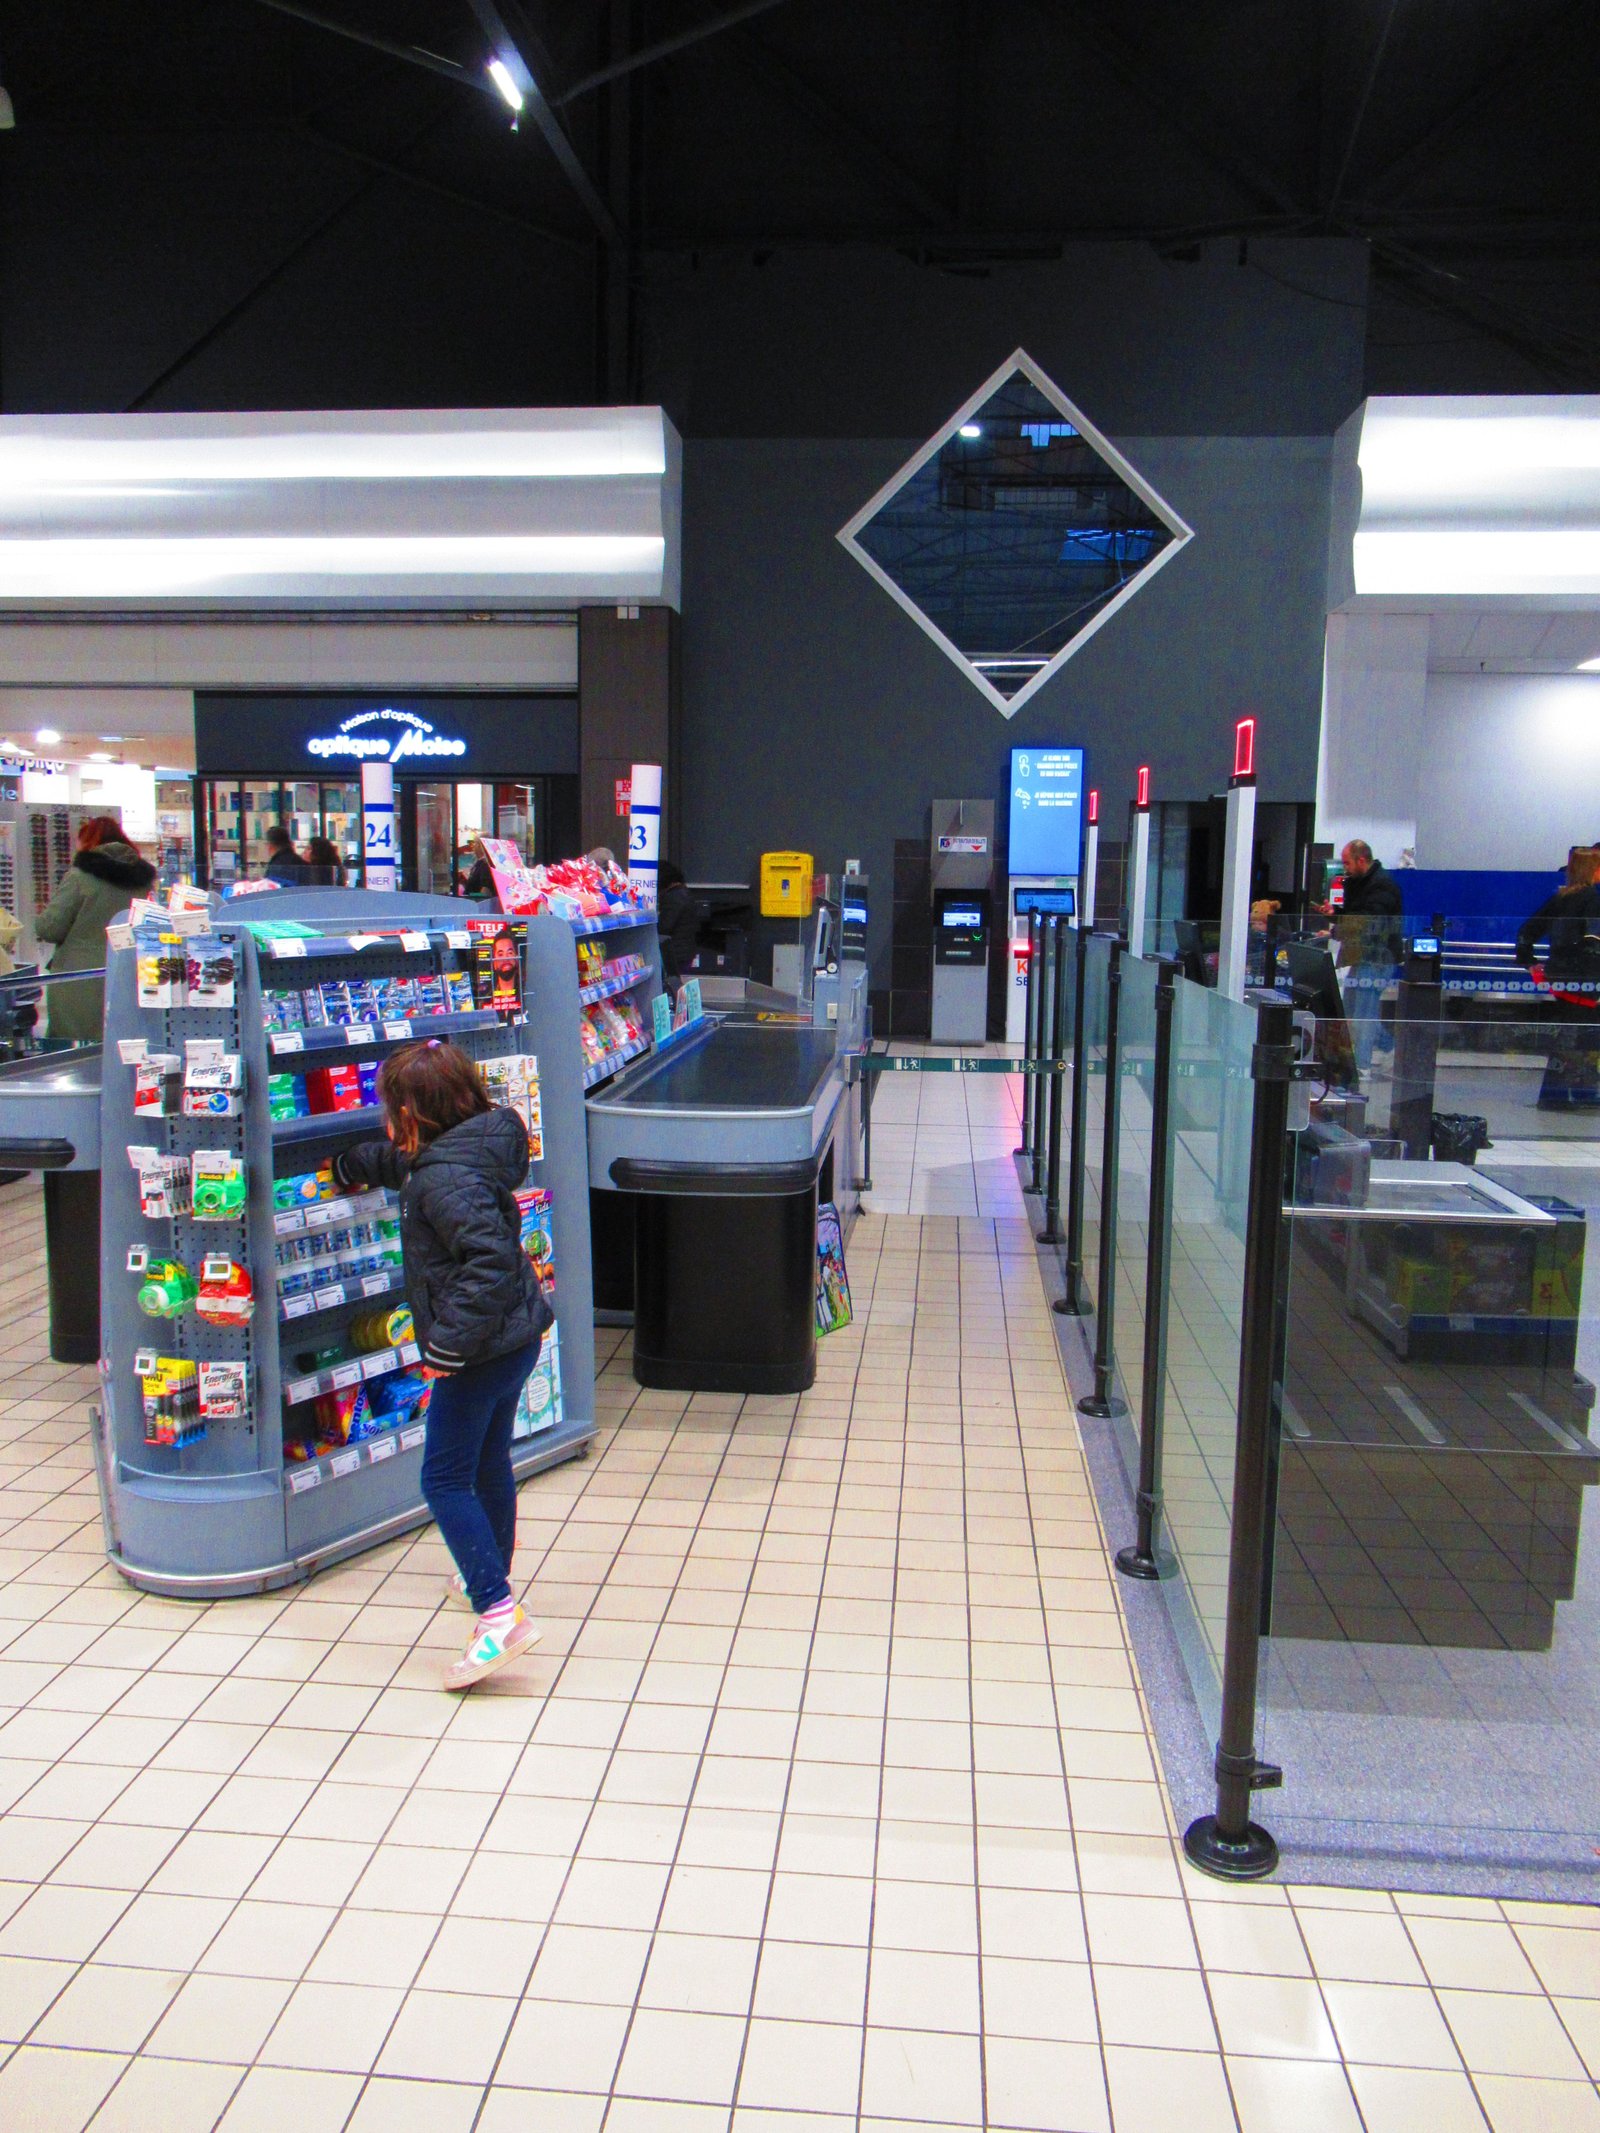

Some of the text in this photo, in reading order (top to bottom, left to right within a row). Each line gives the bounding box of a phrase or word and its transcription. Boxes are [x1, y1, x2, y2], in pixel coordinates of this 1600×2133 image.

[340, 709, 433, 733] Maison d'optique
[308, 735, 391, 764] optique
[366, 823, 391, 847] 24
[191, 1064, 232, 1077] Energizer
[205, 1371, 241, 1385] Energizer
